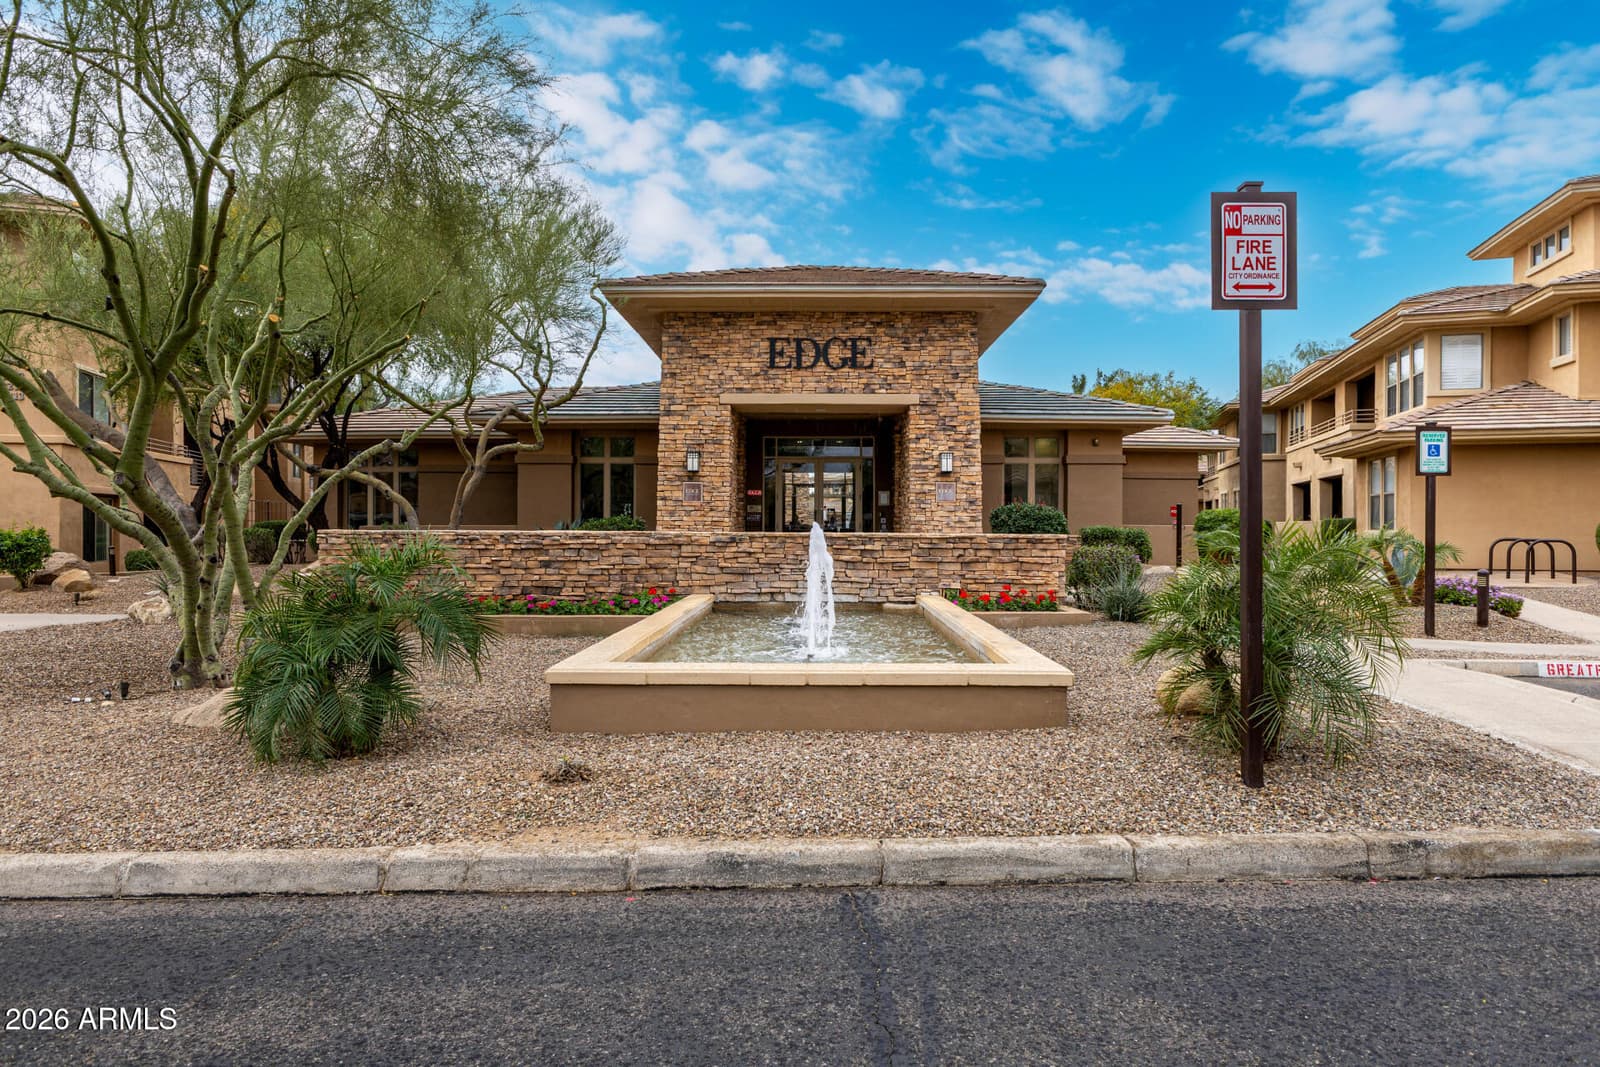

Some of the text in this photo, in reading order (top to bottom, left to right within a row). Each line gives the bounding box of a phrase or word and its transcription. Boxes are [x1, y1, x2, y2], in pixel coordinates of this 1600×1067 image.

[1225, 211, 1281, 230] NO PARKING
[1236, 240, 1273, 254] FIRE
[1232, 256, 1277, 271] LANE
[1228, 272, 1281, 280] CITY ORDINANCE
[767, 336, 874, 370] EDGE
